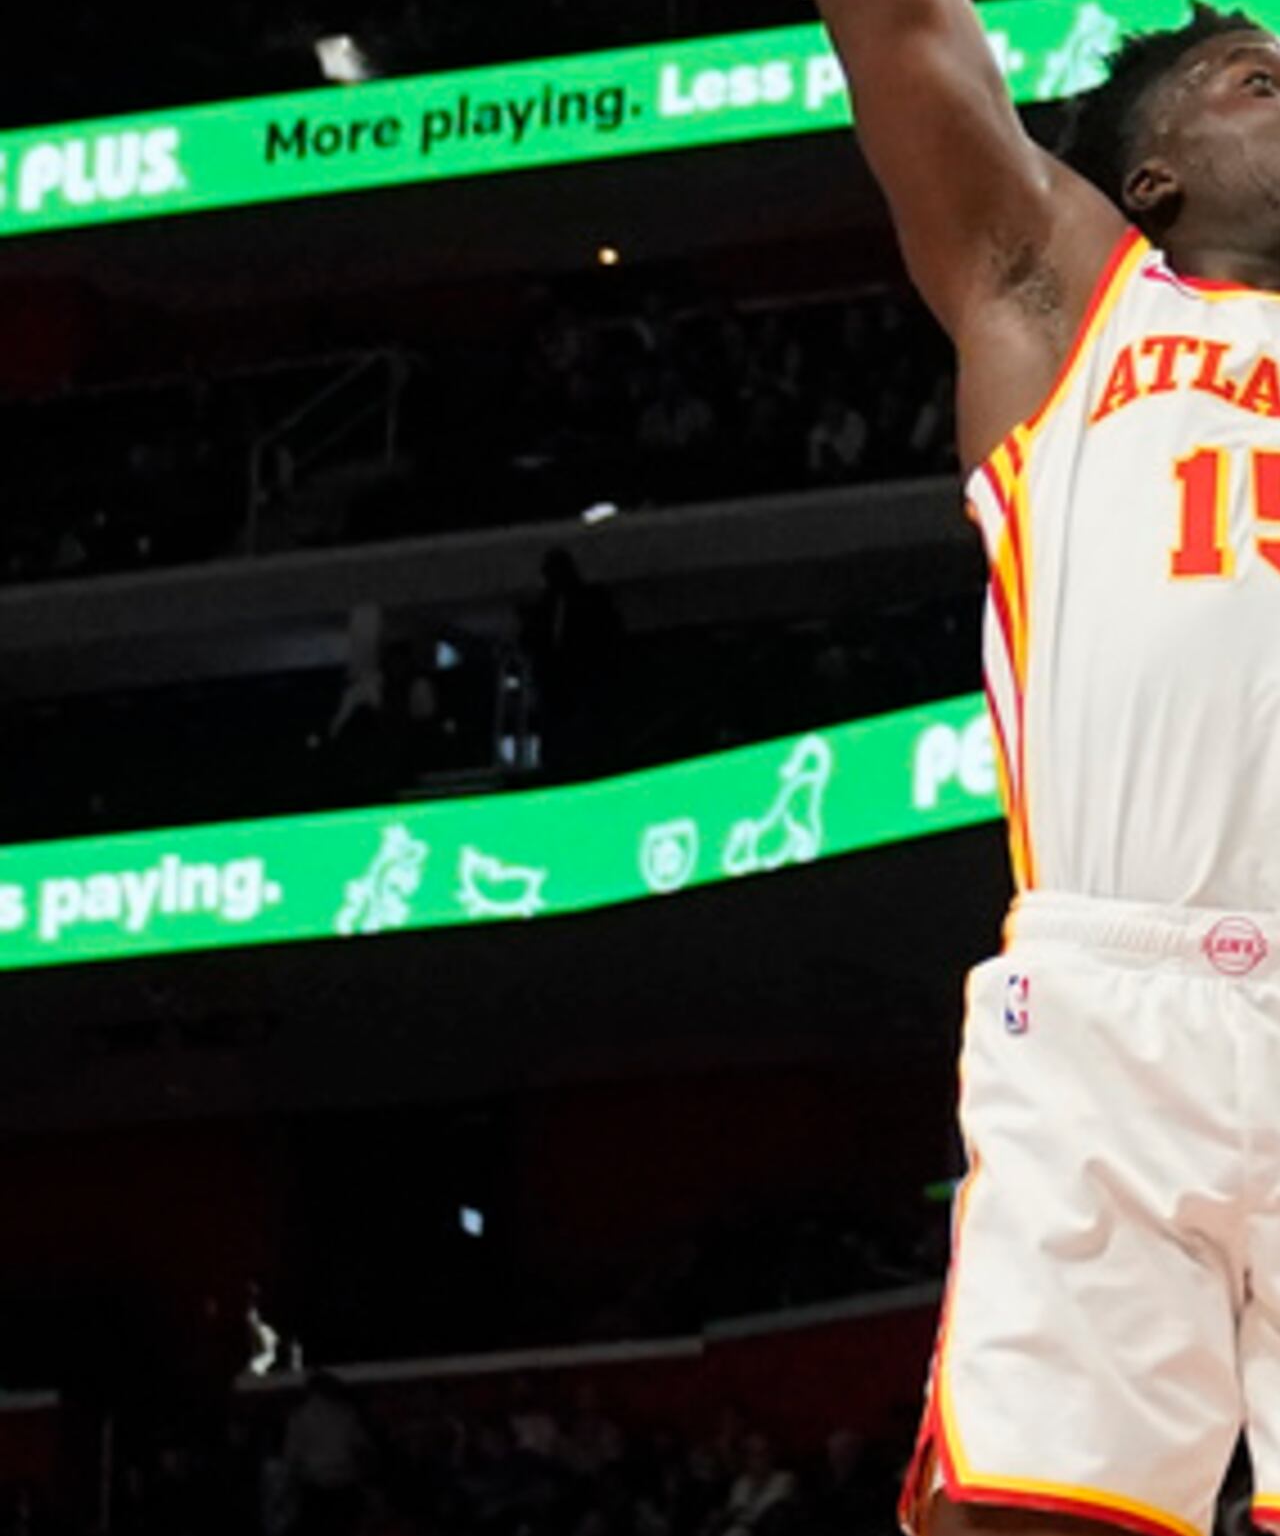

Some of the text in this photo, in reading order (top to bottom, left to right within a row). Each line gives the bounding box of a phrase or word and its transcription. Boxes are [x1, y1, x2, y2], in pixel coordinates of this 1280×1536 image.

[263, 119, 401, 163] More
[420, 81, 642, 156] playing.
[657, 59, 794, 117] Less
[913, 715, 998, 809] PE
[40, 855, 282, 941] paying.
